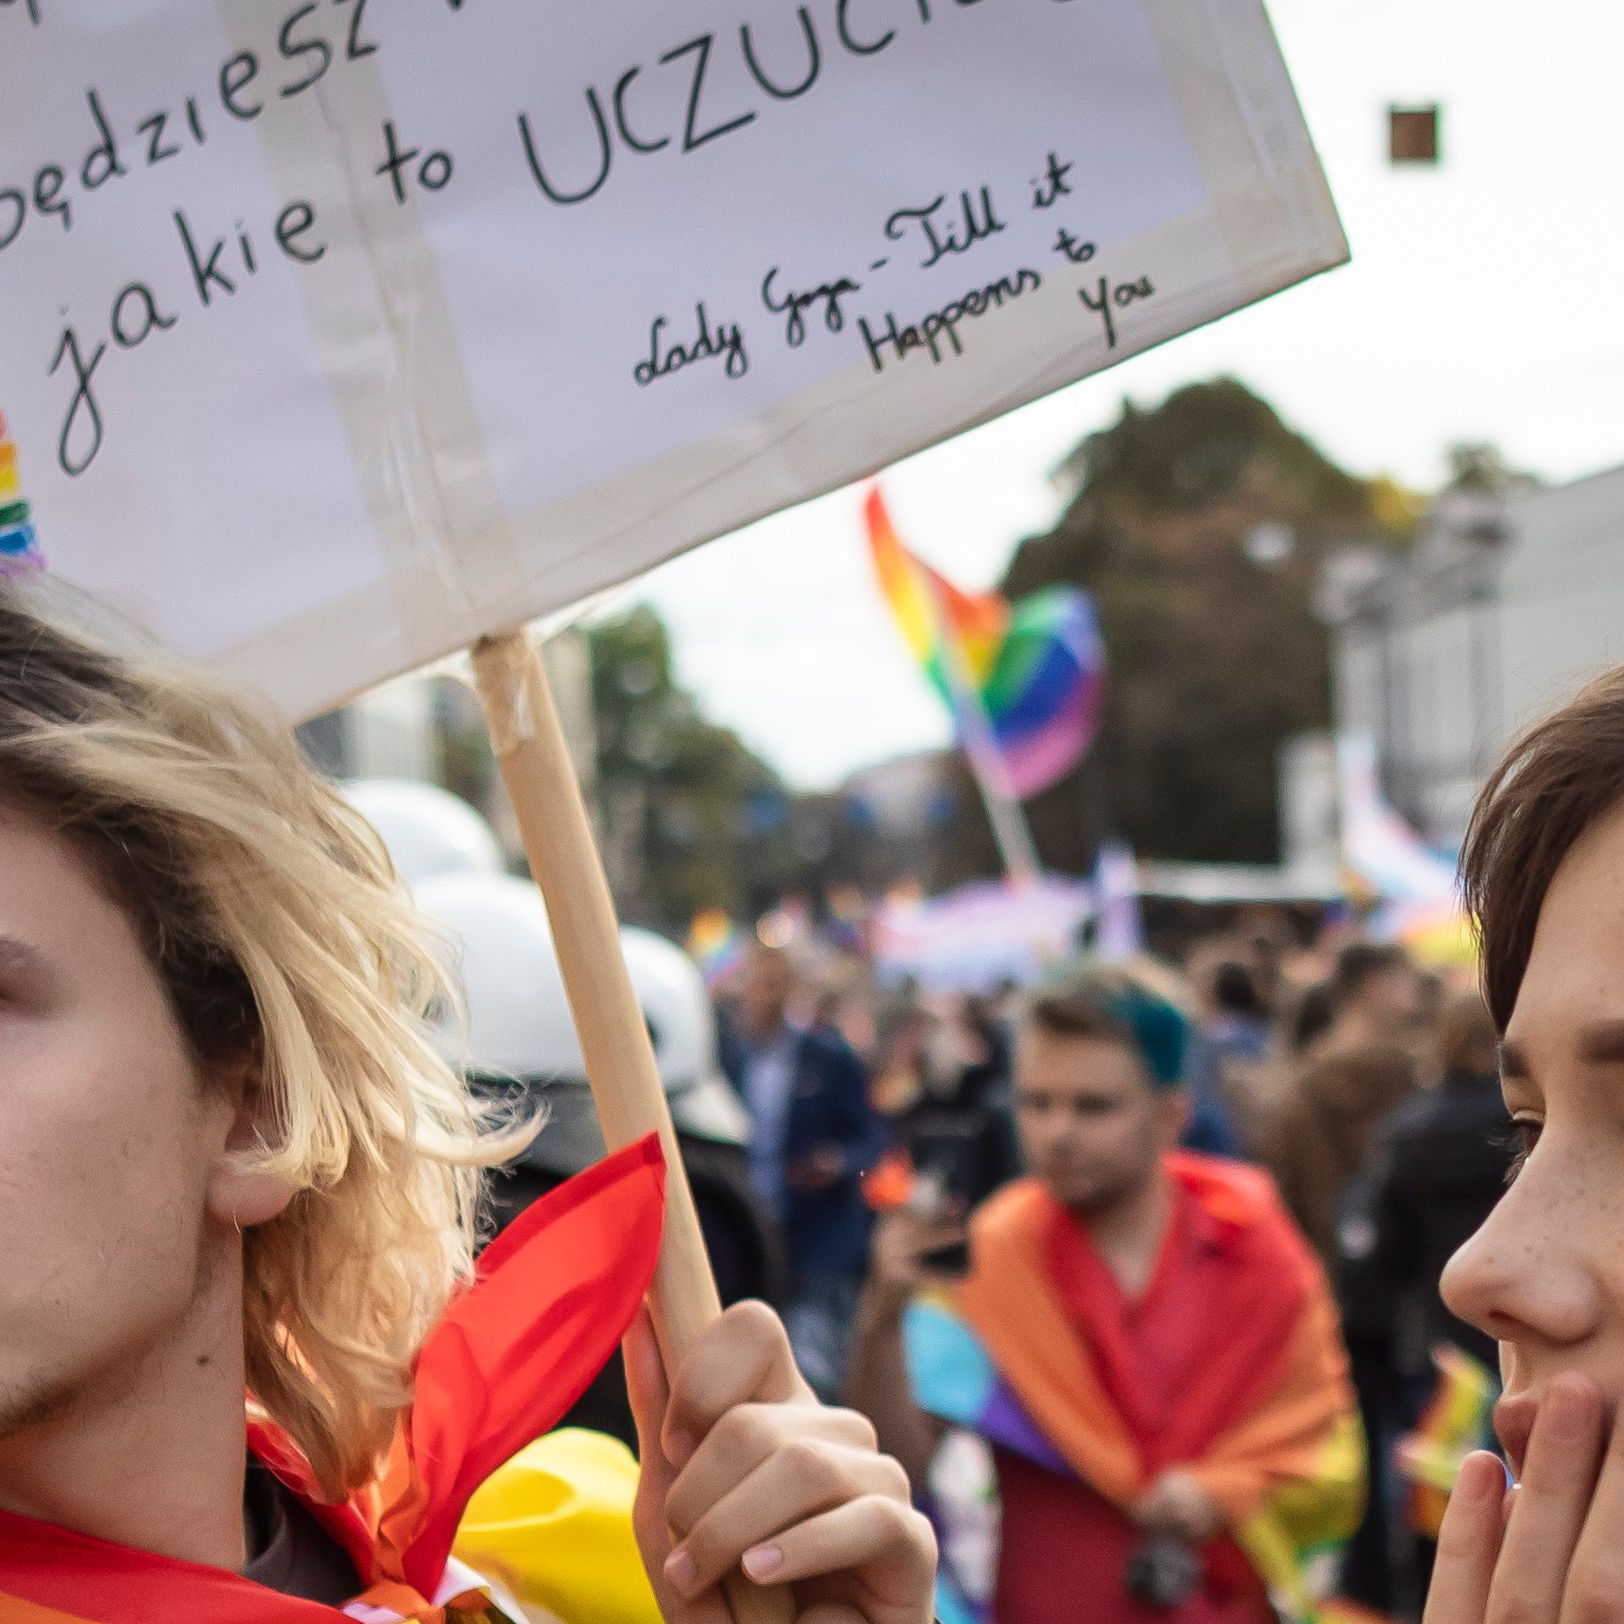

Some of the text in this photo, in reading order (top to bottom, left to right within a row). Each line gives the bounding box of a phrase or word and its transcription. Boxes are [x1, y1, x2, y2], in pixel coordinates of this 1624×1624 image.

[49, 0, 984, 477] jakie to UCZUC
[633, 301, 749, 387] Lady
[1031, 152, 1073, 209] it
[1052, 228, 1098, 264] to
